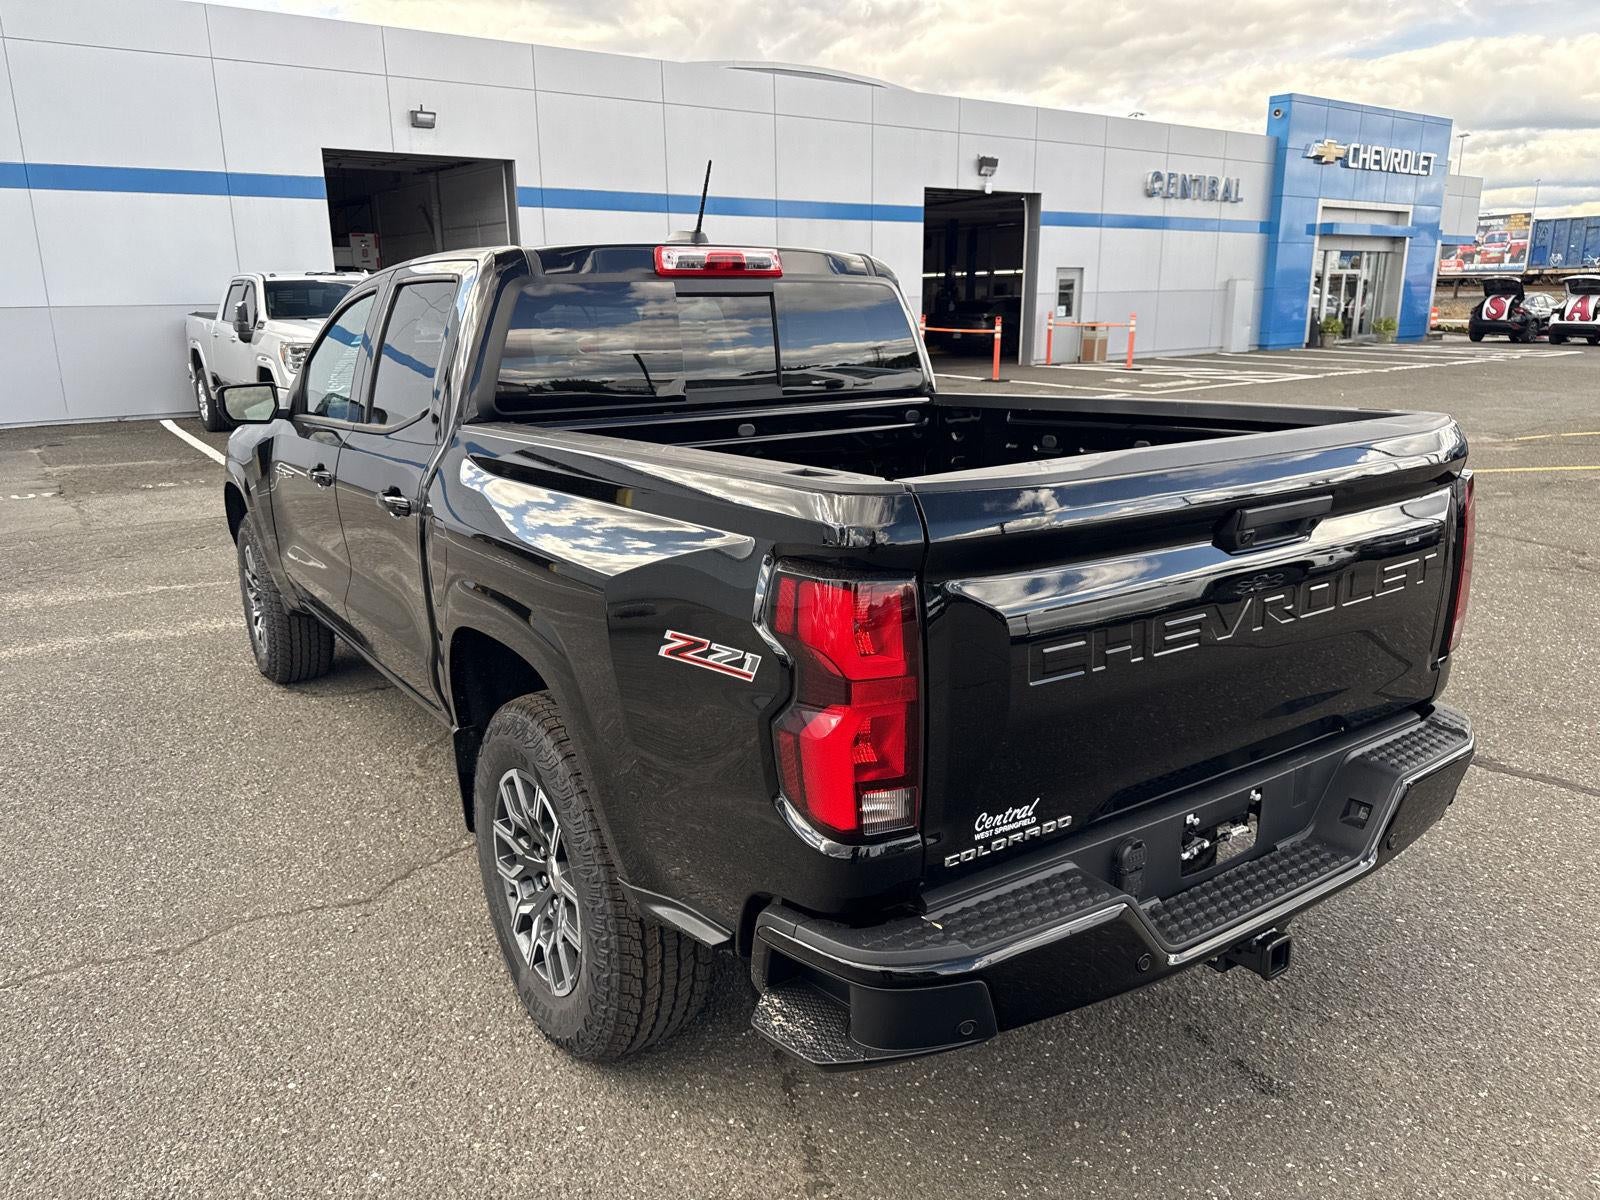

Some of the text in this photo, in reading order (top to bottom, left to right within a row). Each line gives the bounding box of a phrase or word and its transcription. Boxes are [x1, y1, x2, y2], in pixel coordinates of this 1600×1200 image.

[1347, 142, 1438, 176] CHEVROLET
[1144, 170, 1243, 203] CENTRAL
[1485, 295, 1507, 320] S
[1566, 295, 1592, 321] A
[1028, 552, 1438, 686] CHEVROLET
[658, 629, 762, 682] Z71
[974, 797, 1040, 832] Central
[974, 816, 1037, 841] WEST SPRINGFIELD
[944, 815, 1073, 867] COLORADO
